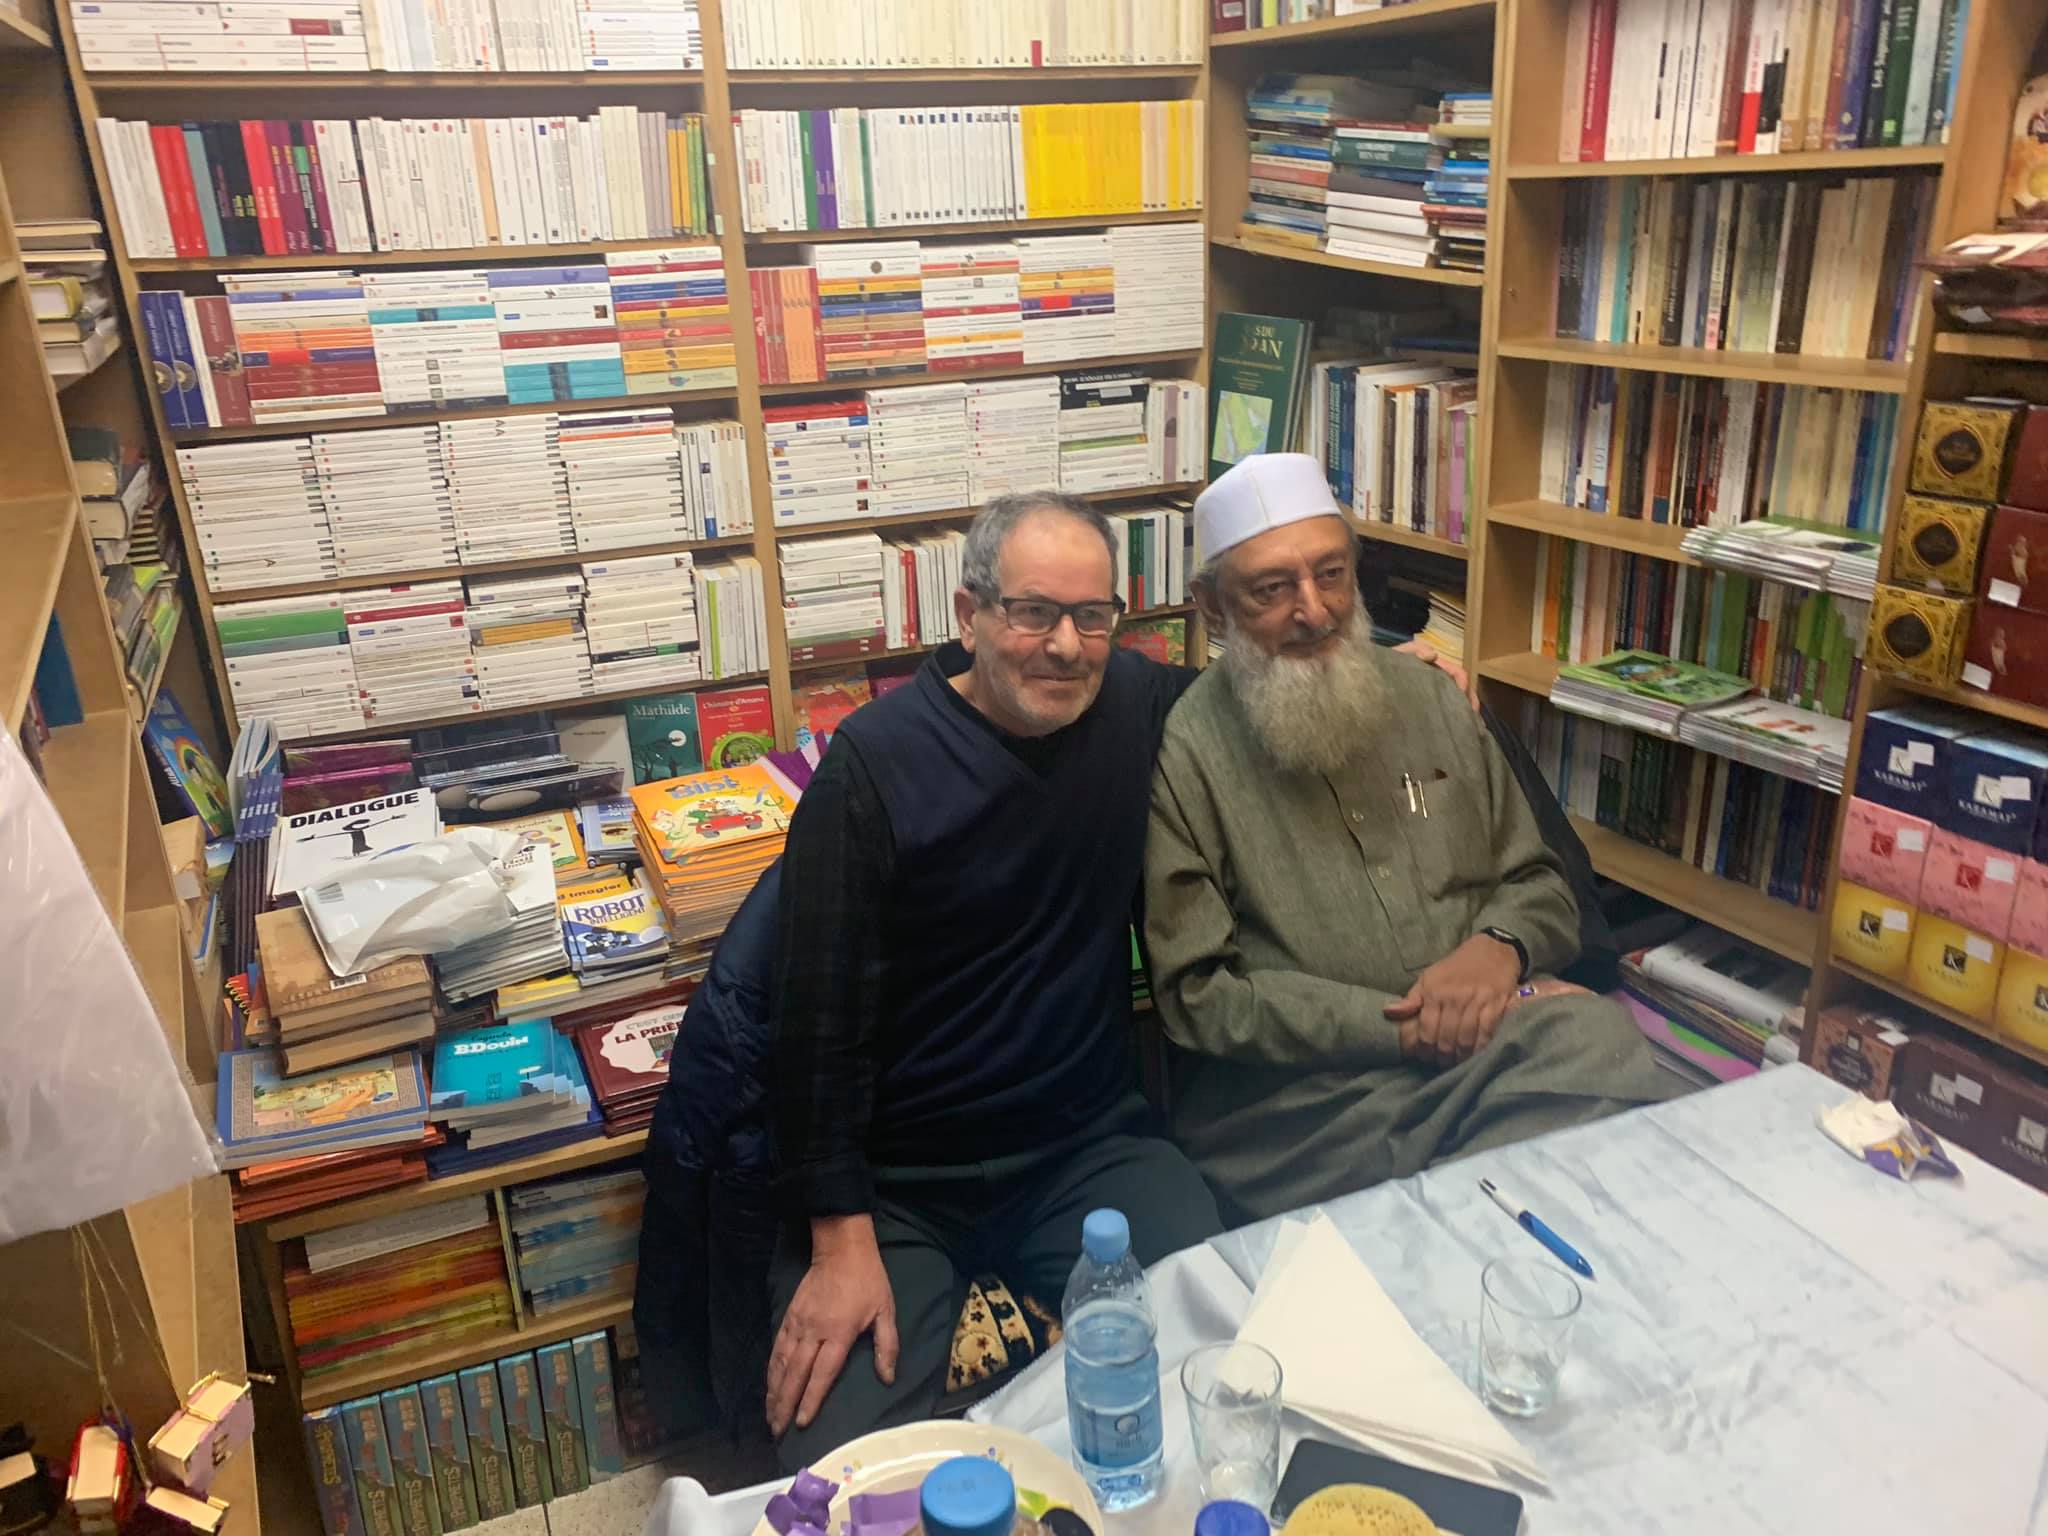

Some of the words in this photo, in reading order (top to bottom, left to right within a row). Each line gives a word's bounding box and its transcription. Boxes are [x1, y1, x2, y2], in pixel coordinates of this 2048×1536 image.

[632, 703, 691, 716] Mathilde
[290, 792, 420, 829] DIALOGUE
[574, 894, 645, 922] ROBOT
[615, 1033, 636, 1044] LA
